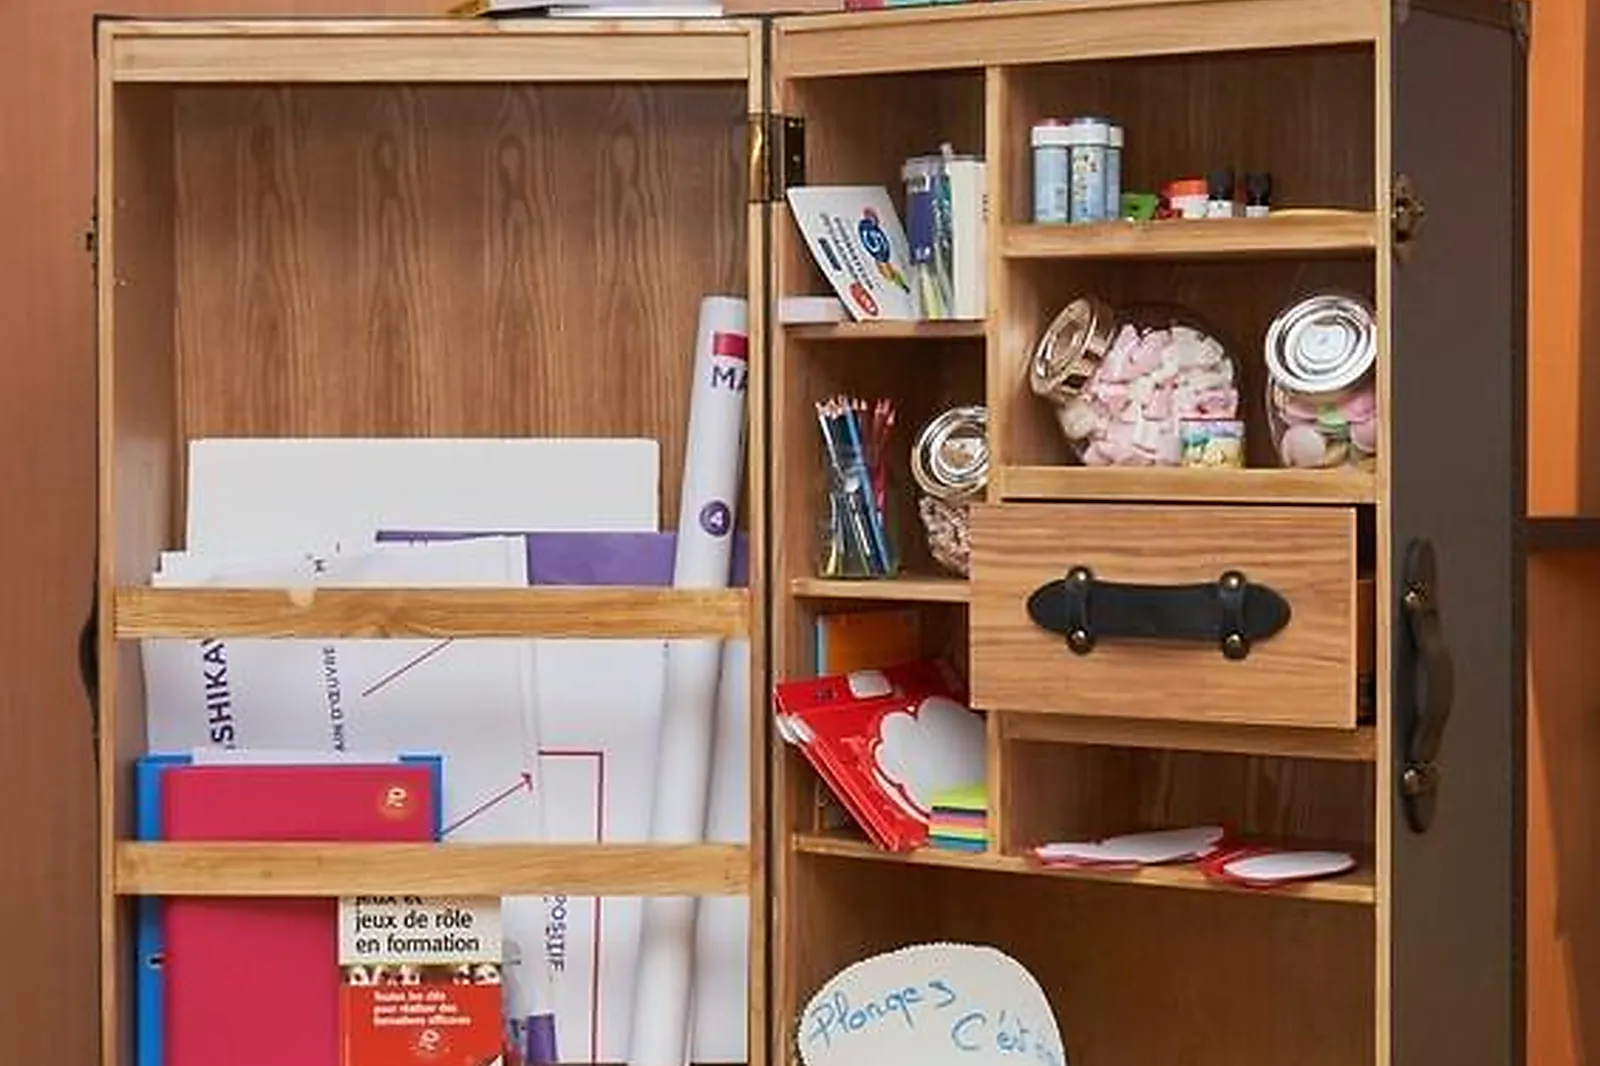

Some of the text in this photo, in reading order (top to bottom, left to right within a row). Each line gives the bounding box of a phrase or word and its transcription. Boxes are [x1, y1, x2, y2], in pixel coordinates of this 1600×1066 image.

[201, 639, 236, 750] SHIKA
[356, 906, 473, 932] jeux de rôle
[356, 933, 480, 952] en formation
